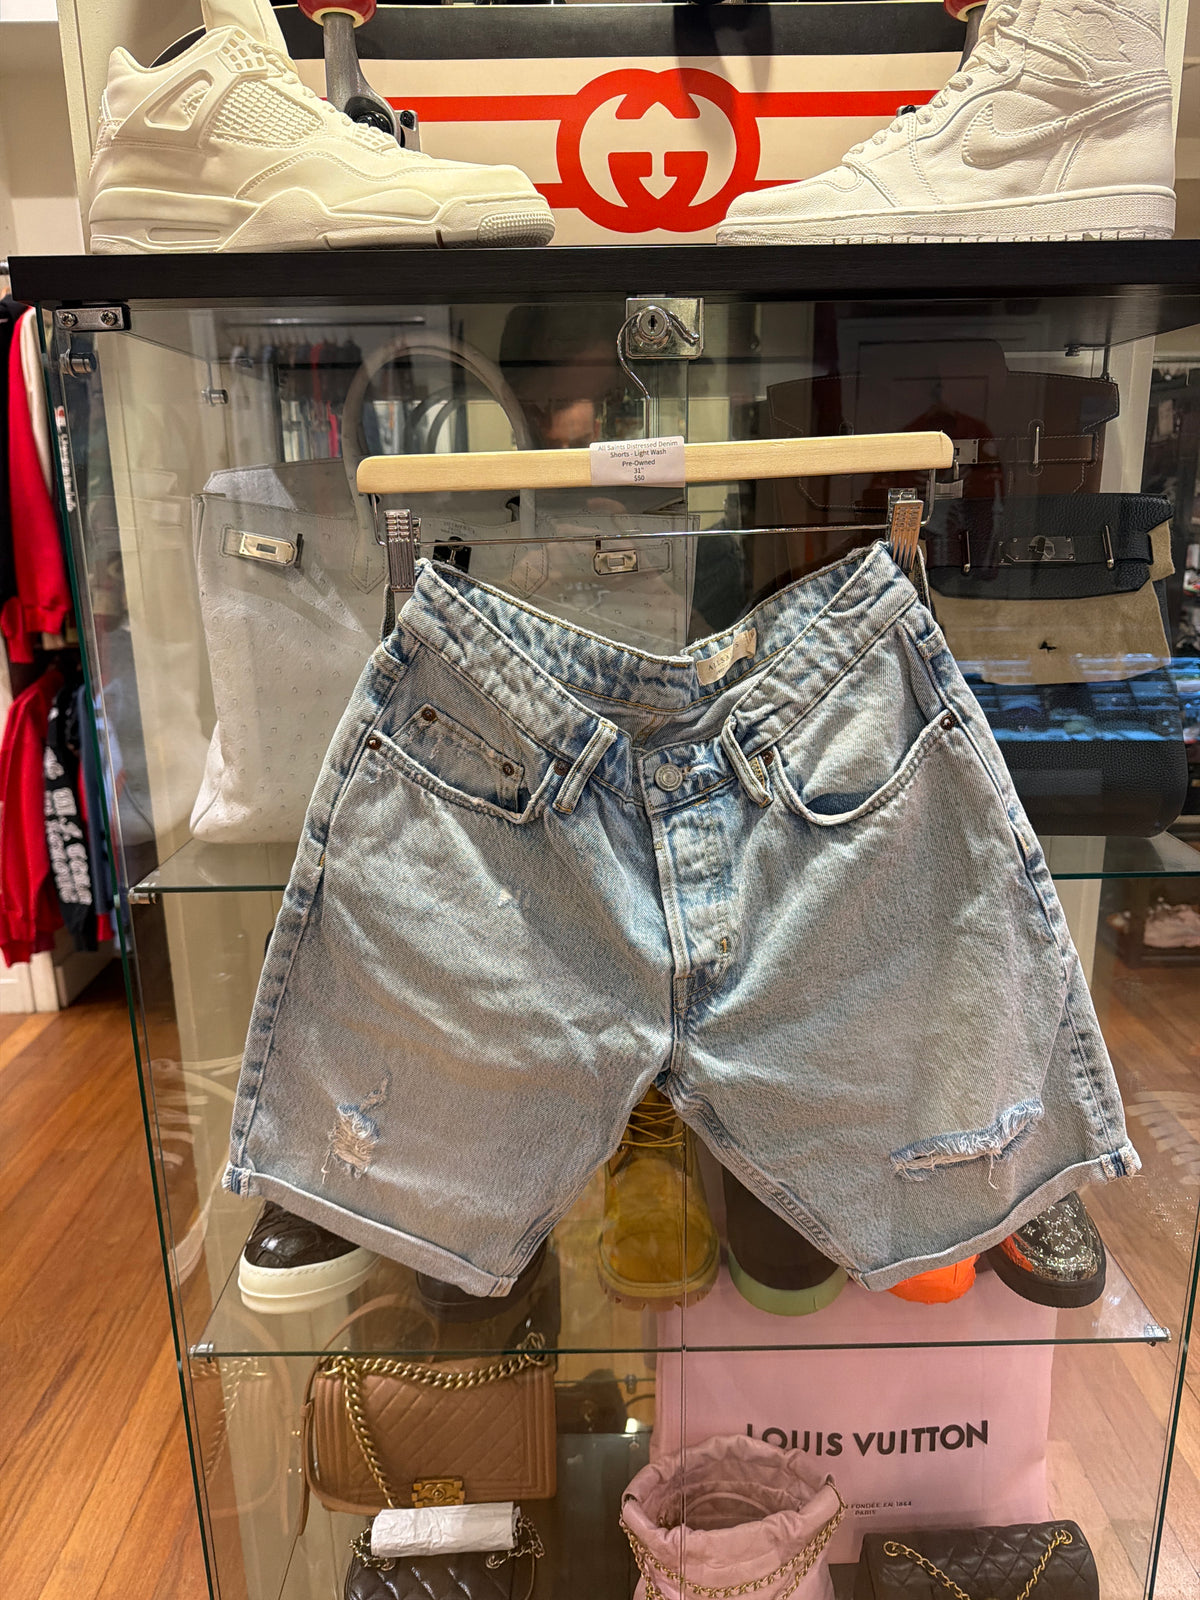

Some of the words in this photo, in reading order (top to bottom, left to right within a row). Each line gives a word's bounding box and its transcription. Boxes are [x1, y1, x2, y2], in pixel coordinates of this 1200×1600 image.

[627, 441, 657, 449] Distressed
[634, 450, 649, 458] Light
[622, 459, 656, 467] Pre-Owned
[853, 1420, 988, 1457] VUITTON
